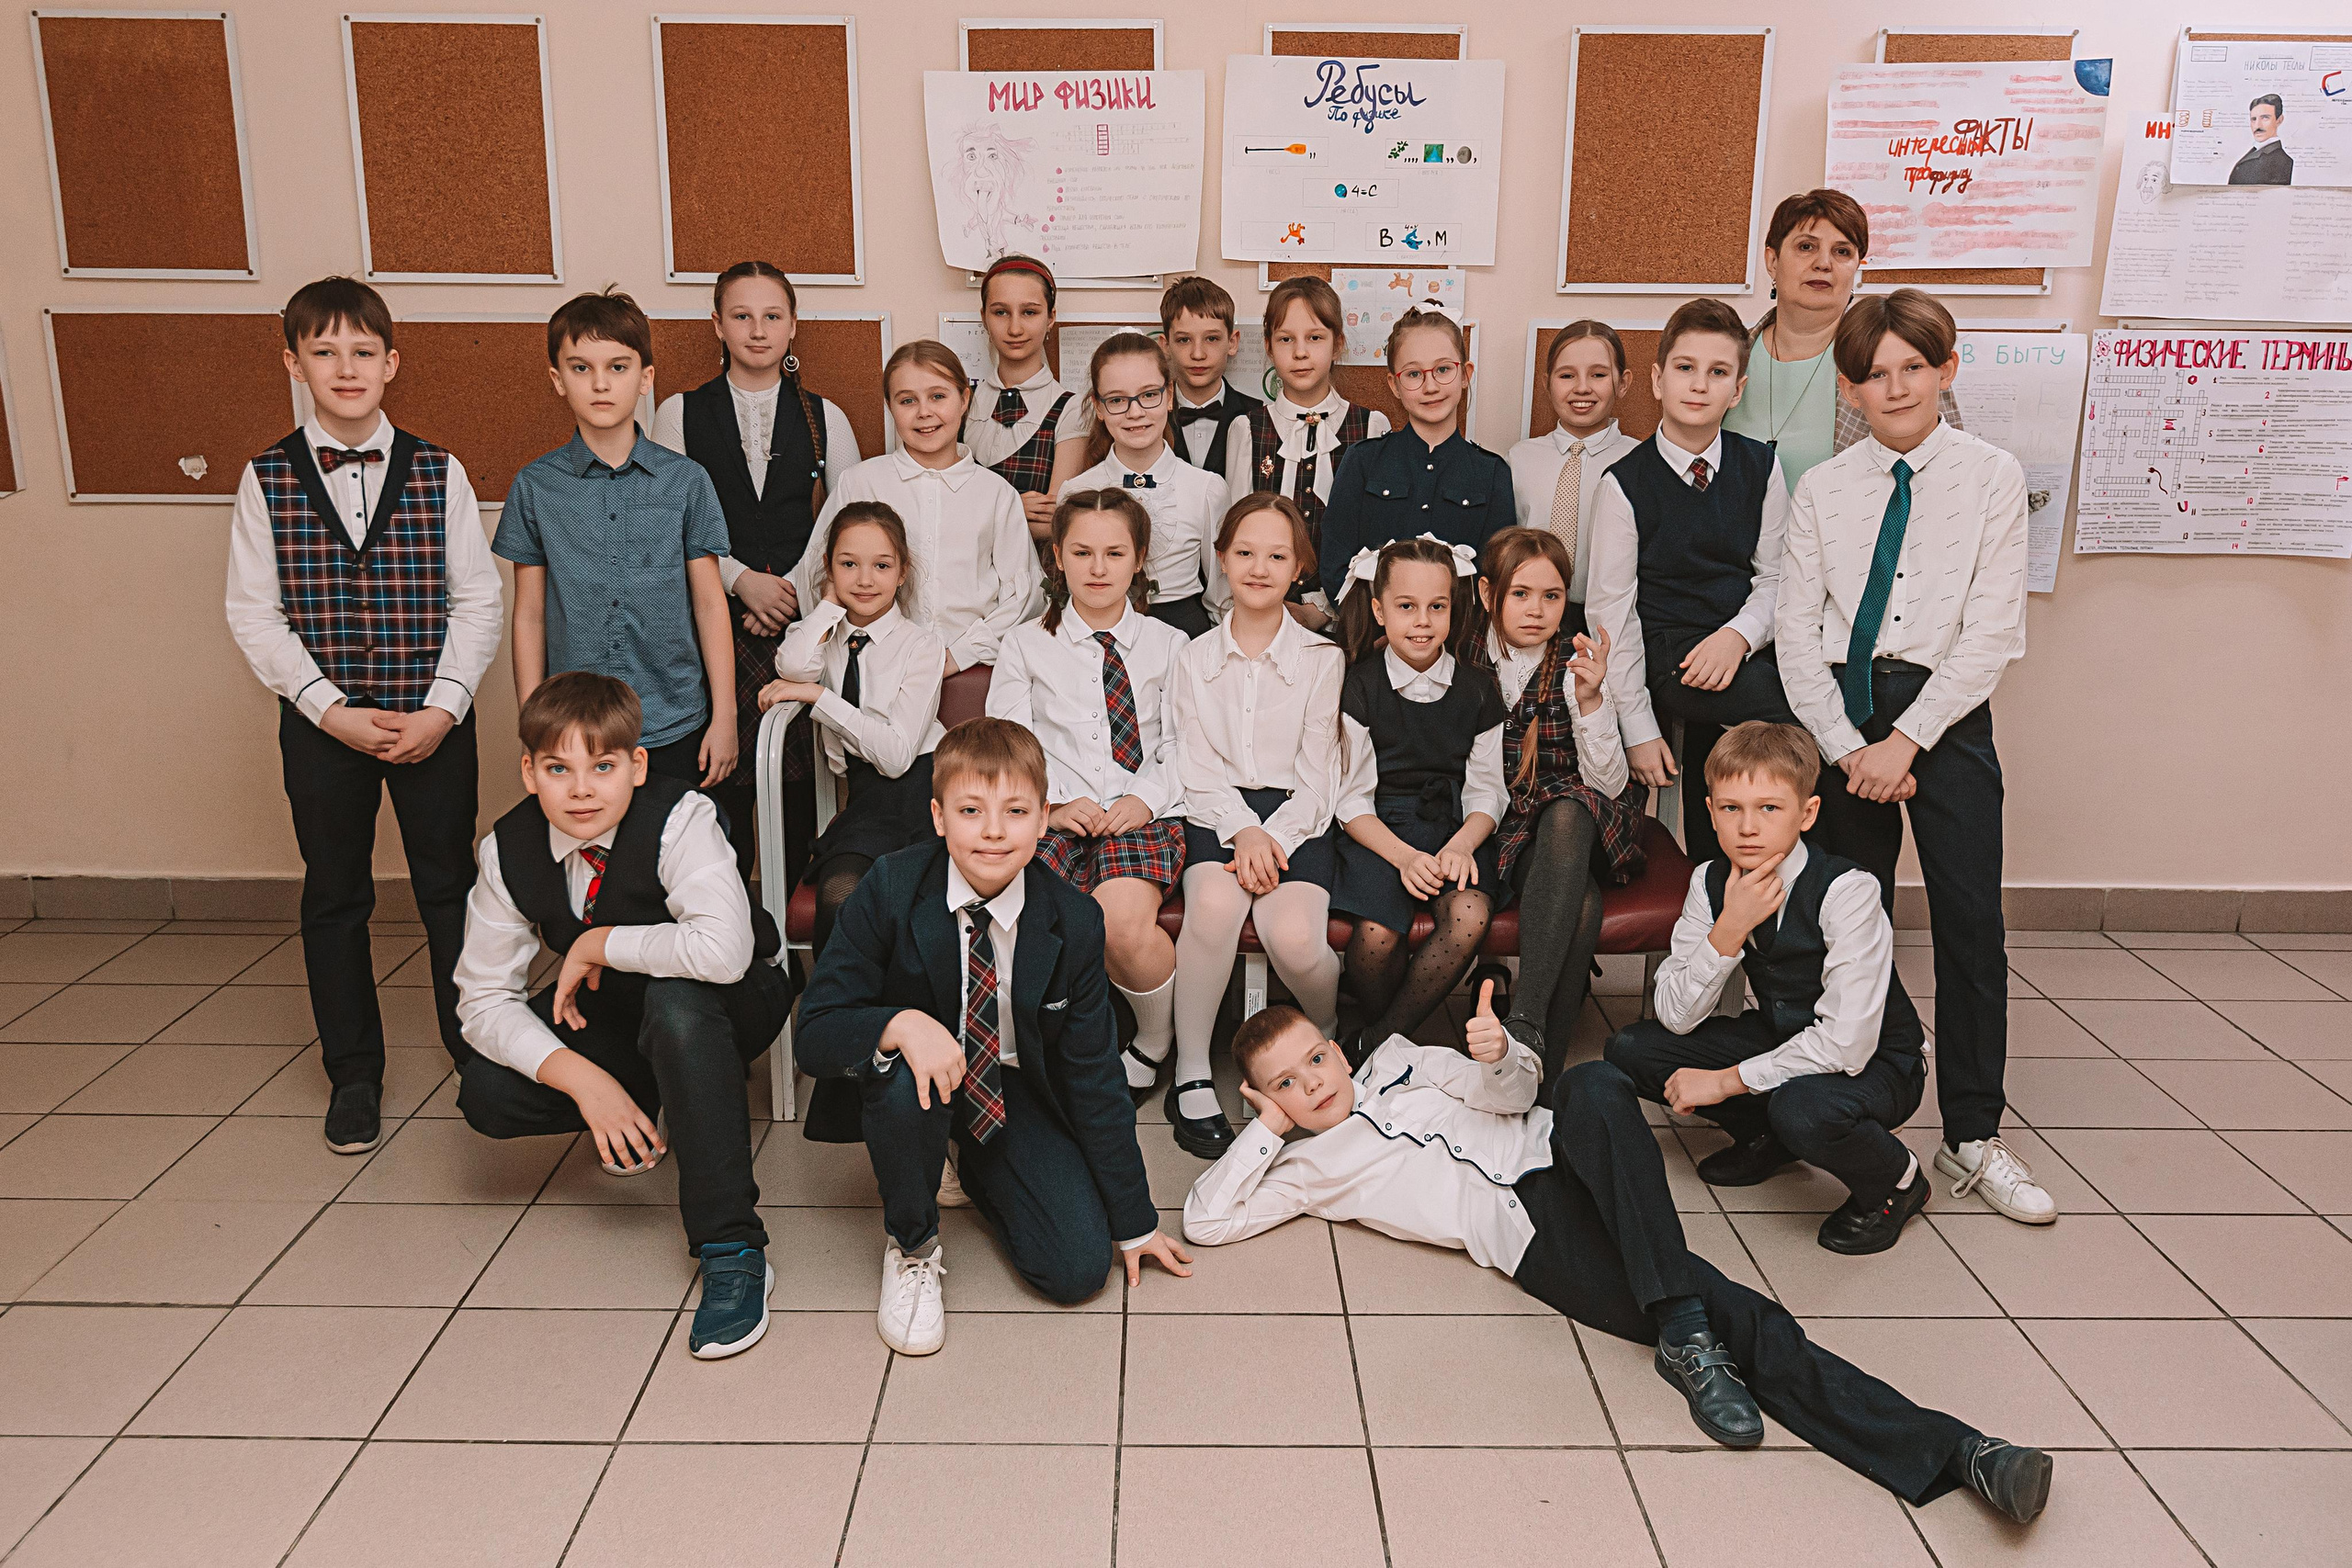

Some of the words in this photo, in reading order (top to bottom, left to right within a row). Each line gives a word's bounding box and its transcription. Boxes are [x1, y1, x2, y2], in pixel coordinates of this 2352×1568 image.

[2244, 61, 2278, 71] НИКОЛЫ
[2283, 61, 2306, 71] ТЕСЛЫ
[988, 81, 1045, 112] МИР
[1054, 76, 1157, 110] ФИЗИКИ
[1304, 60, 1427, 121] Ребусы
[1328, 105, 1348, 121] По
[2144, 120, 2176, 139] ИН
[1962, 344, 1975, 364] В
[1996, 344, 2066, 365] БЫТУ
[2113, 338, 2250, 369] ФИЗИЧЕСКИЕ
